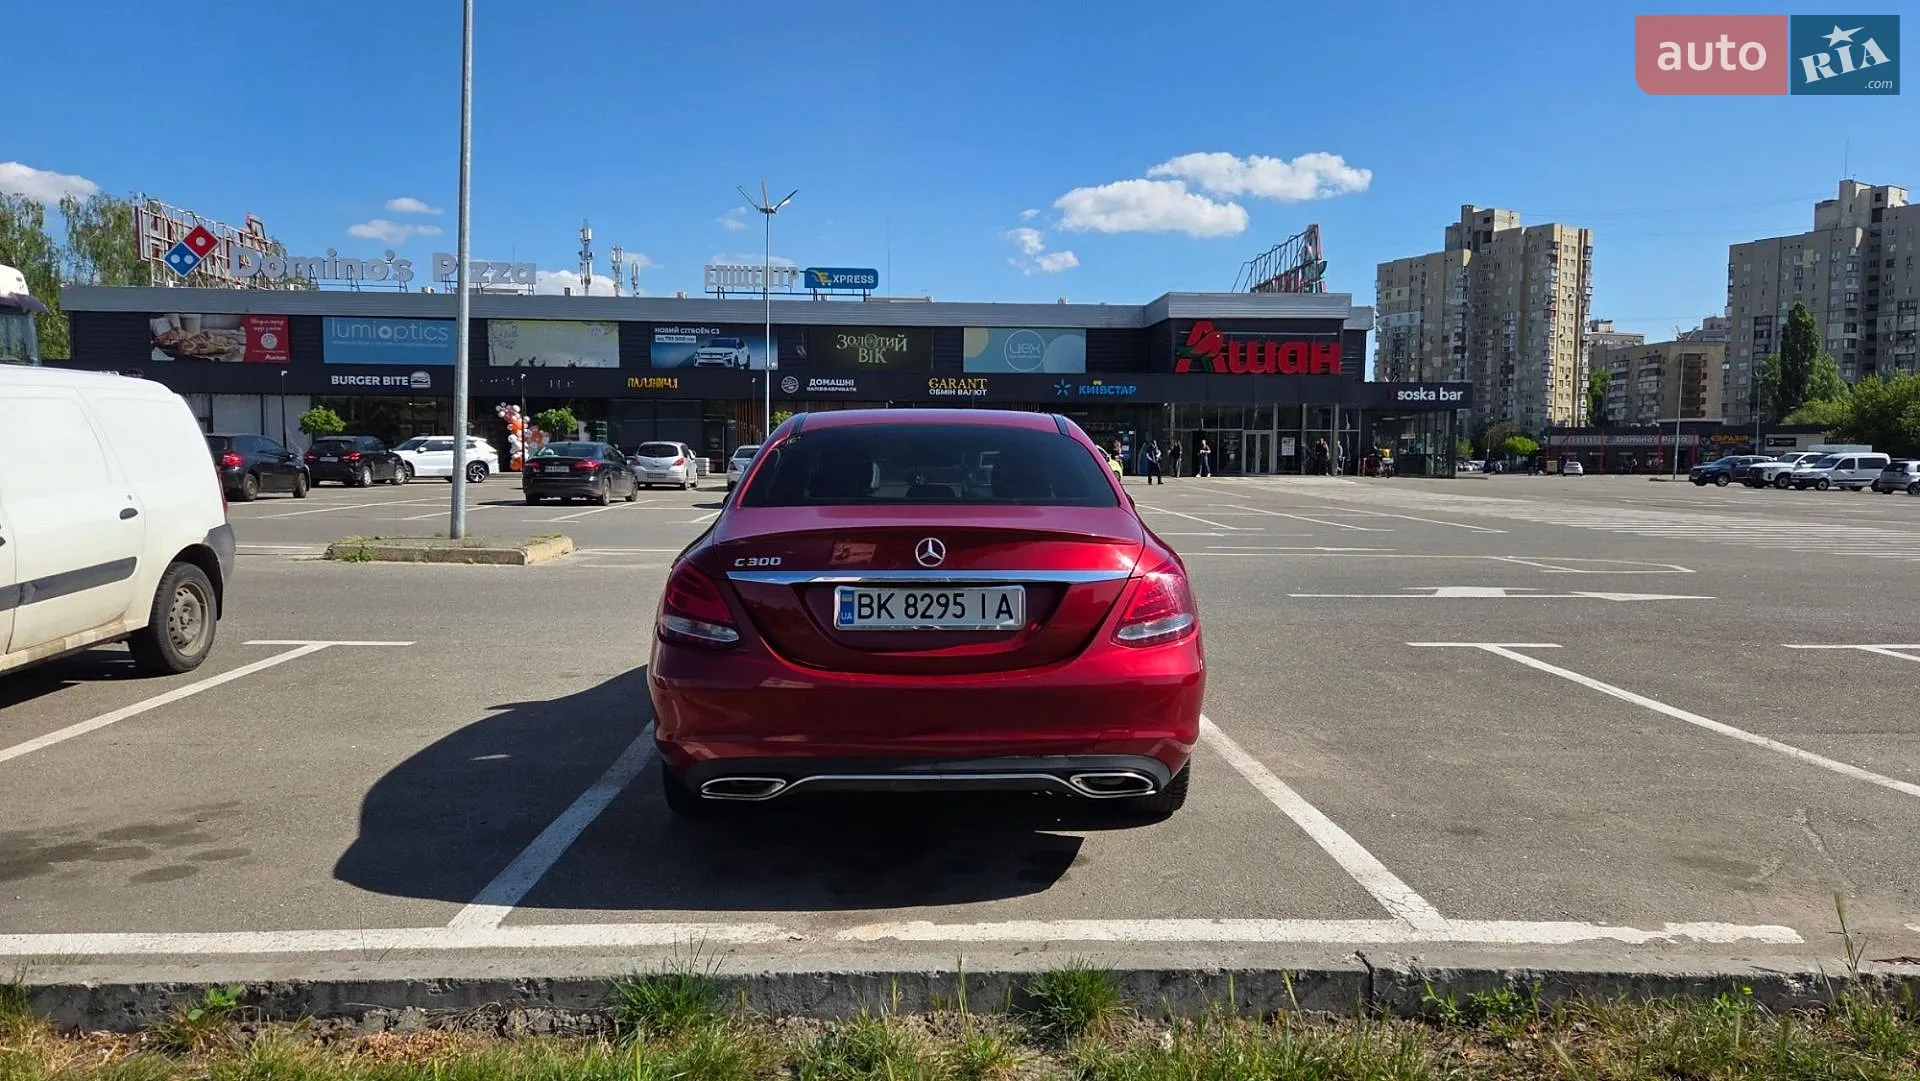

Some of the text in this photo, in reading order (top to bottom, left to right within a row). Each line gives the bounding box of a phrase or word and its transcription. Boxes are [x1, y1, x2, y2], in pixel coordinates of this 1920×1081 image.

[229, 247, 537, 285] Domino's Pzza
[331, 318, 450, 342] lumioptics
[331, 375, 409, 386] BURGER BITE
[809, 378, 855, 387] ДОМАШНІ
[928, 377, 988, 390] GARANT
[1397, 386, 1463, 401] soska bar
[857, 592, 895, 620] BK
[903, 592, 967, 620] 8295
[841, 611, 853, 621] UA
